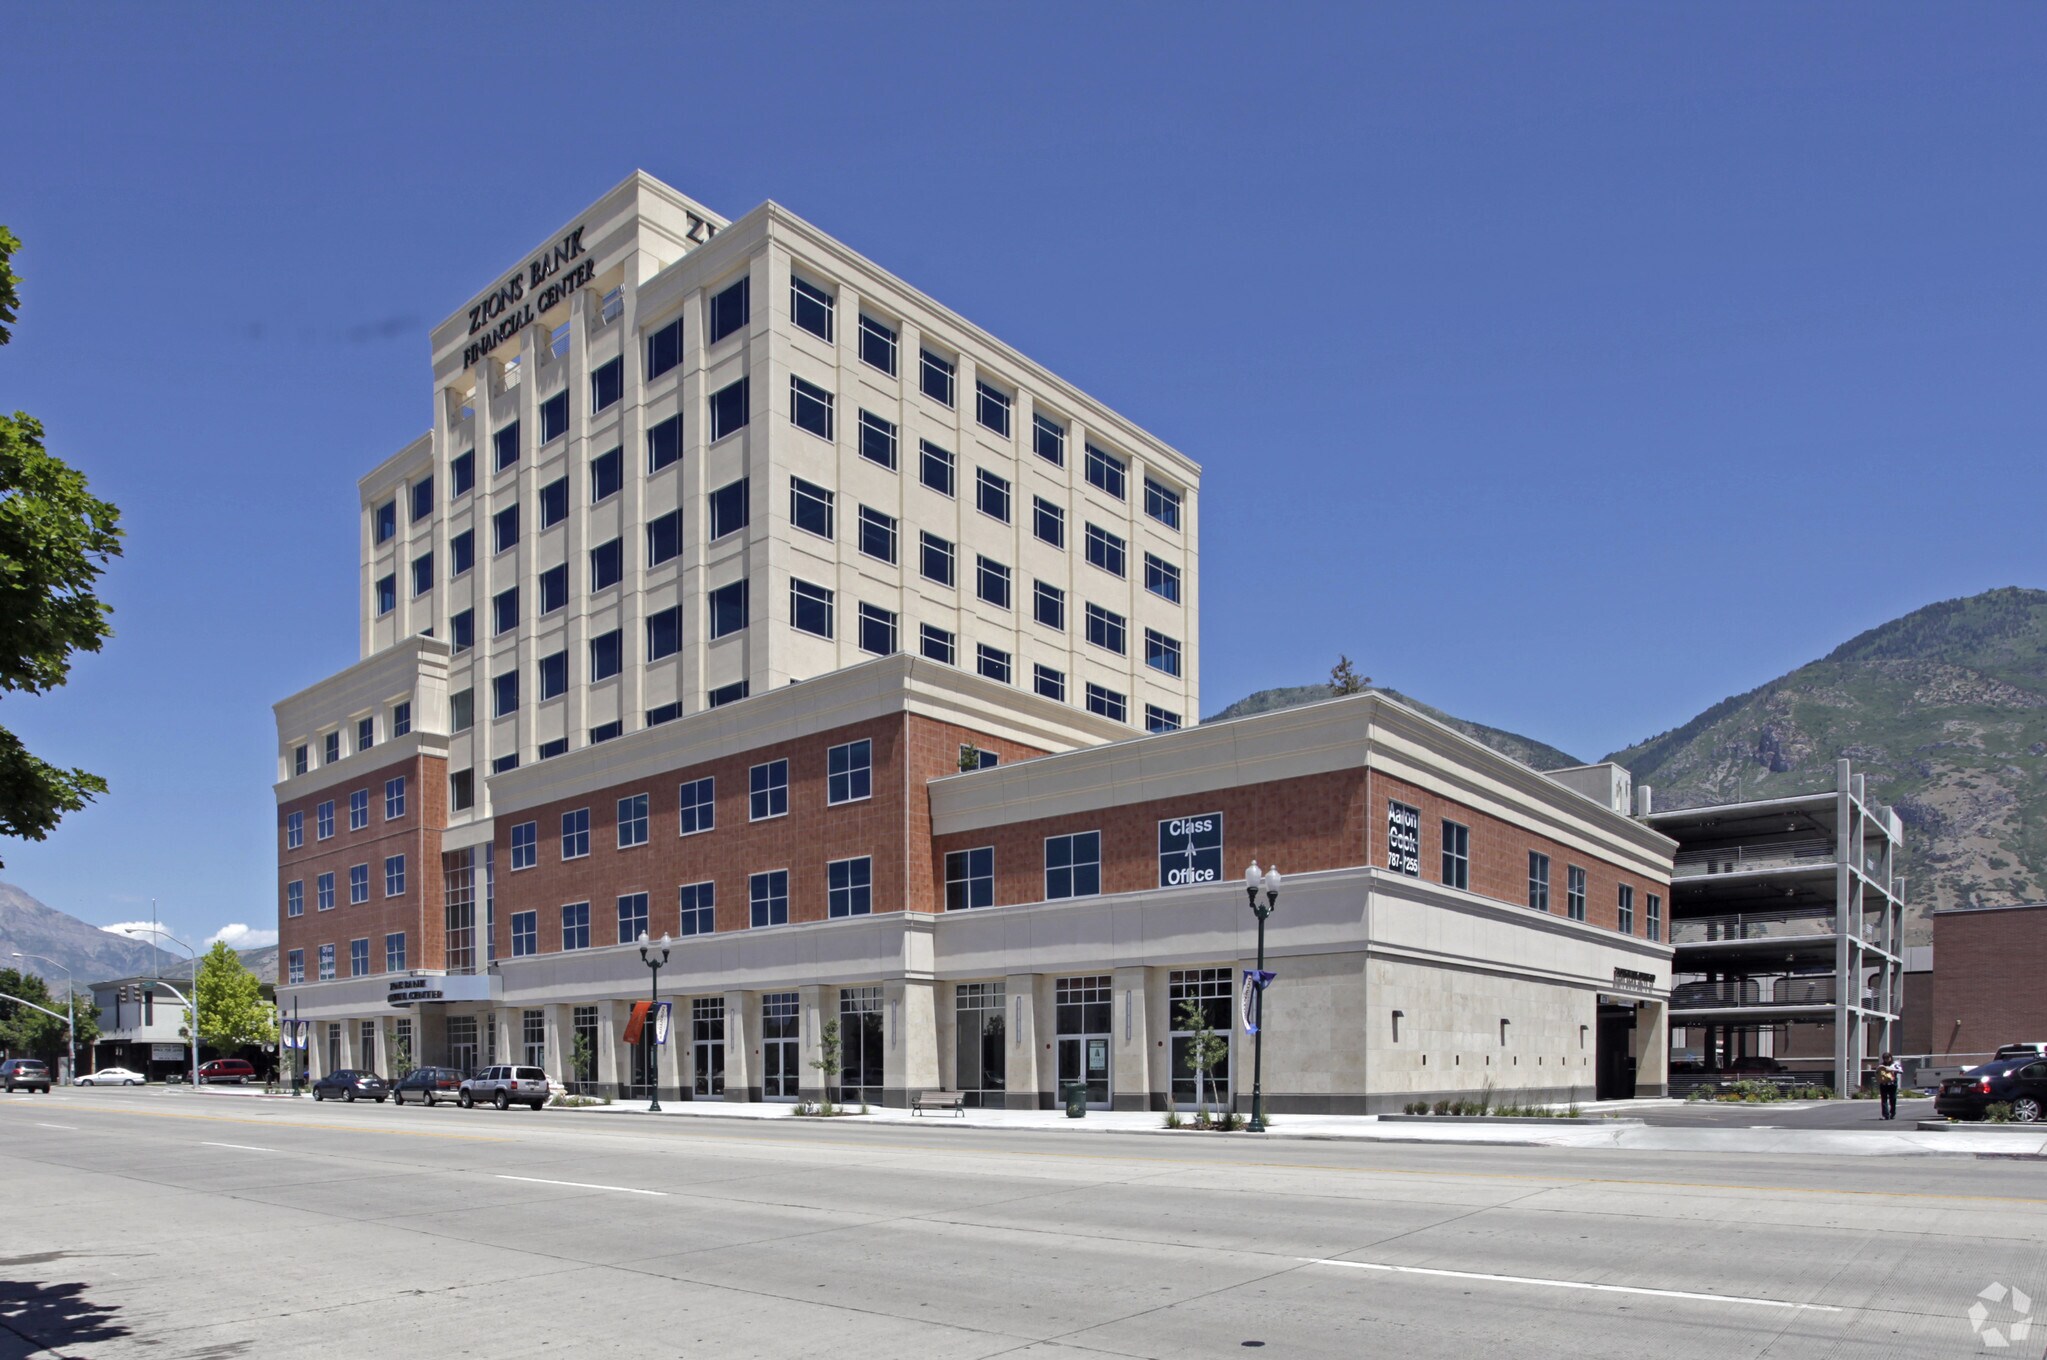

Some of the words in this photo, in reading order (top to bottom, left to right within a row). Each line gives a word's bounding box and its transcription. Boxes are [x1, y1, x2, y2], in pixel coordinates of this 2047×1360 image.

[469, 274, 523, 335] ZIONS
[530, 226, 586, 290] BANK
[463, 304, 534, 370] FINANCIAL
[538, 259, 595, 313] CENTER
[1169, 819, 1213, 836] Class
[1389, 802, 1417, 829] Aaron
[1184, 841, 1197, 857] A
[1390, 826, 1416, 852] Cook
[1168, 867, 1214, 885] Office
